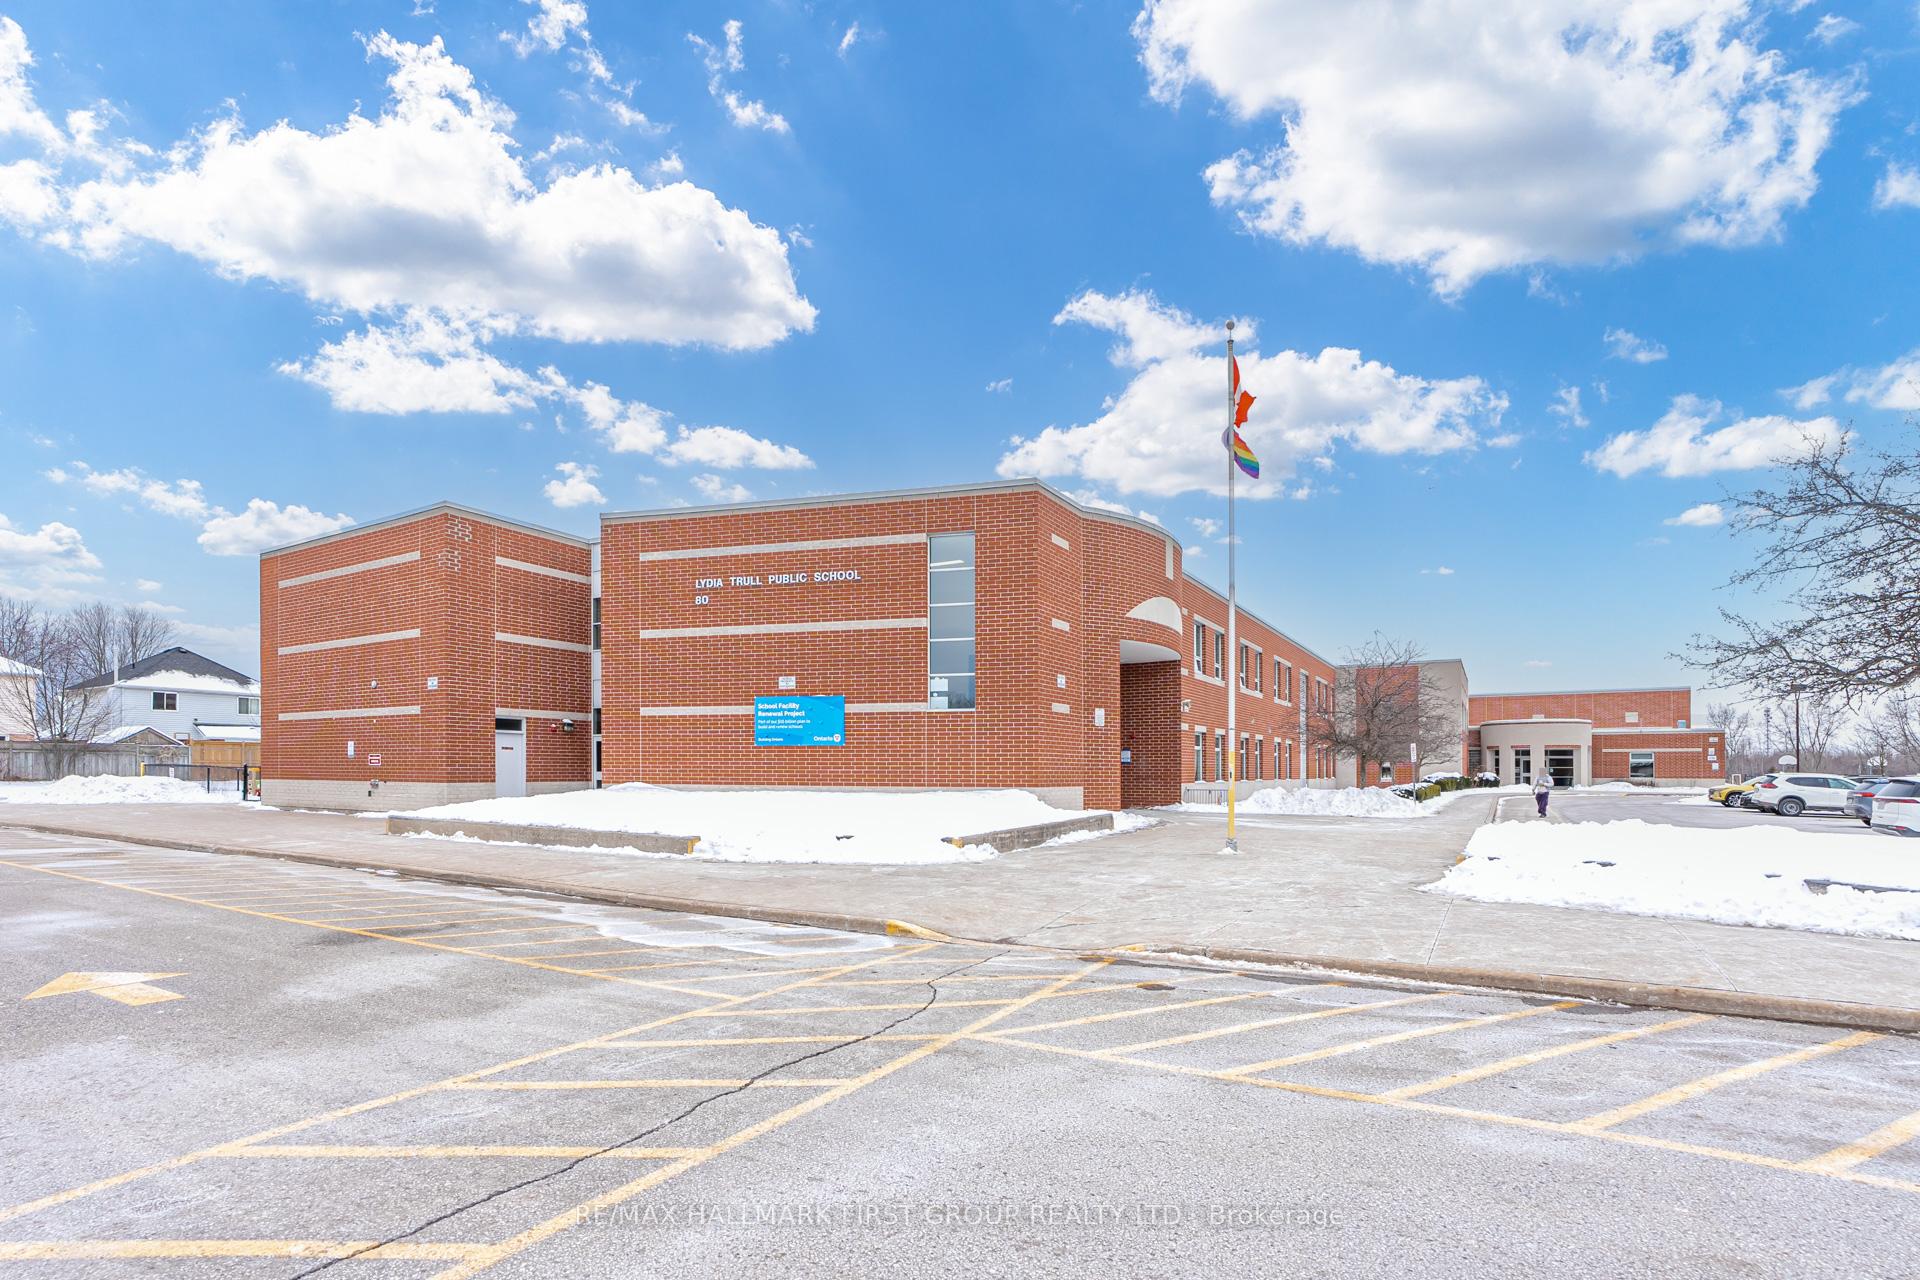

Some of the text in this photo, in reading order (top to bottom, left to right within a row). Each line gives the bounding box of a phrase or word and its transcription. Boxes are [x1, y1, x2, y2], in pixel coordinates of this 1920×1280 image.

[695, 570, 861, 589] LYDIA TRULL PUBLIC SCHOOL
[695, 595, 709, 605] 80
[778, 702, 800, 710] Facility
[784, 710, 805, 718] Project
